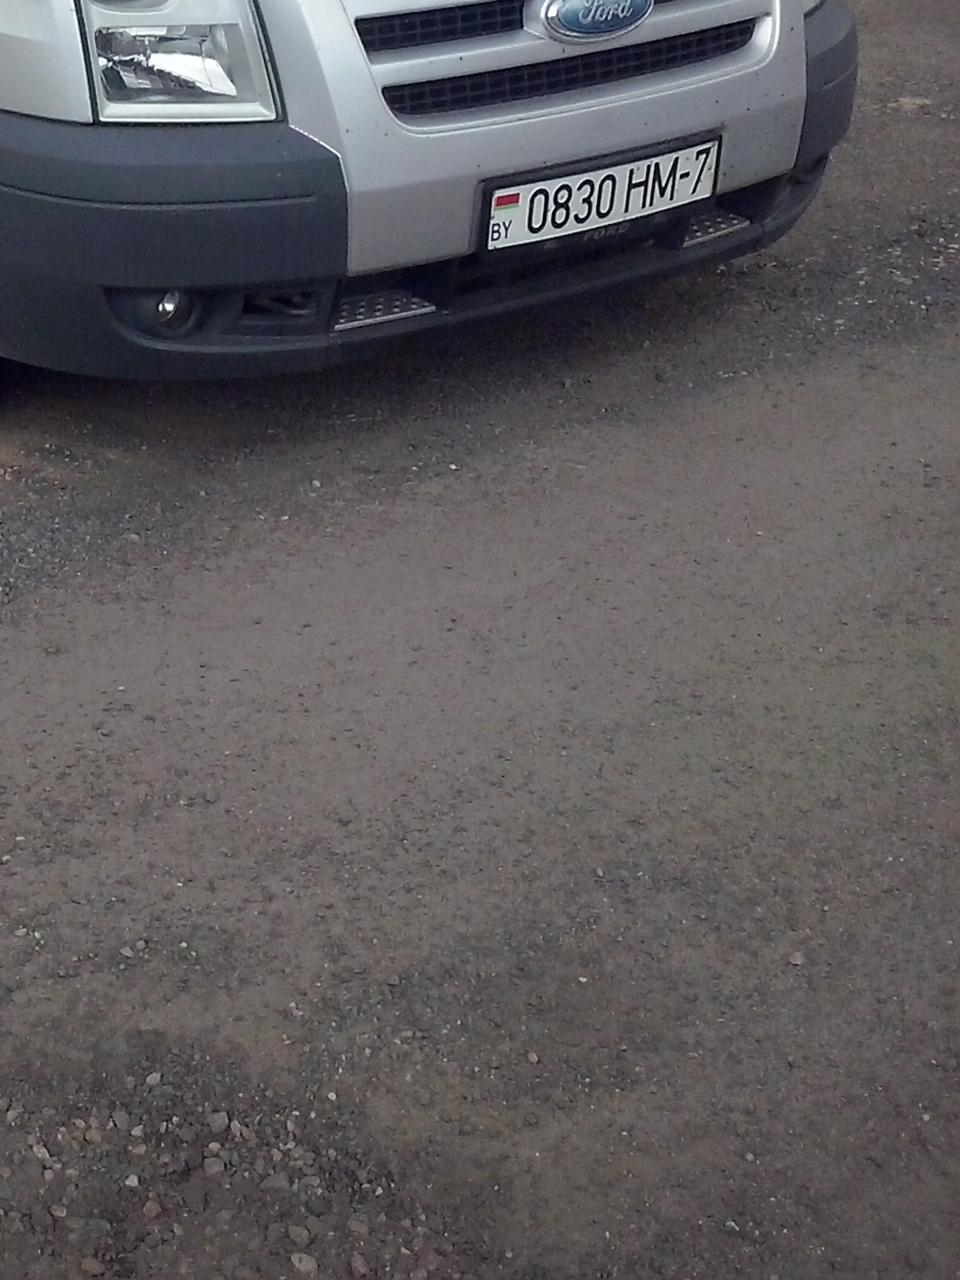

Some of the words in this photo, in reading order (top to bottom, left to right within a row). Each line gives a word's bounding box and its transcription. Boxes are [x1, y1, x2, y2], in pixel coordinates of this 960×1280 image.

[526, 174, 617, 234] 0830
[624, 147, 712, 213] HM-7
[490, 220, 513, 242] BY
